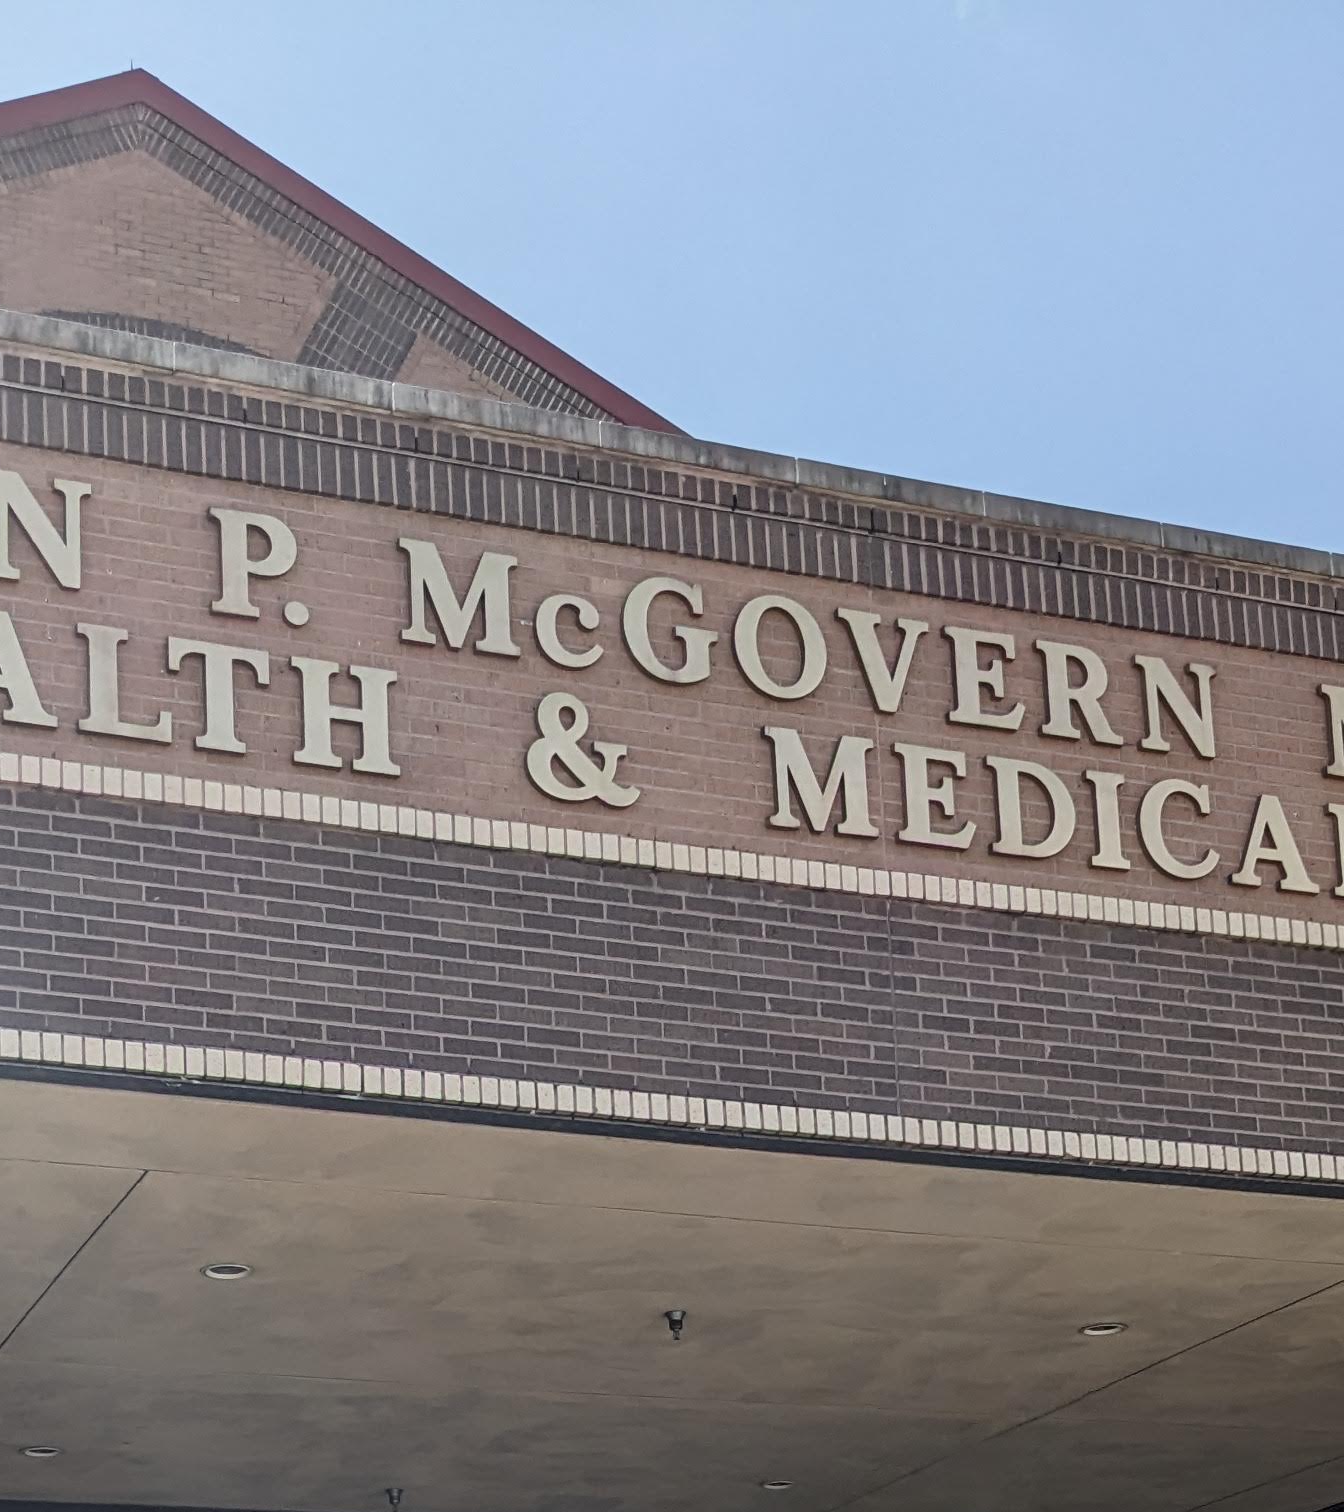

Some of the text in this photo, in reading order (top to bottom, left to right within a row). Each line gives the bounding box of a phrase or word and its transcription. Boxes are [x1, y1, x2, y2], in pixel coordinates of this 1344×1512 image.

[208, 507, 310, 627] P.
[399, 537, 1218, 759] McGOVERN
[526, 691, 641, 807] &
